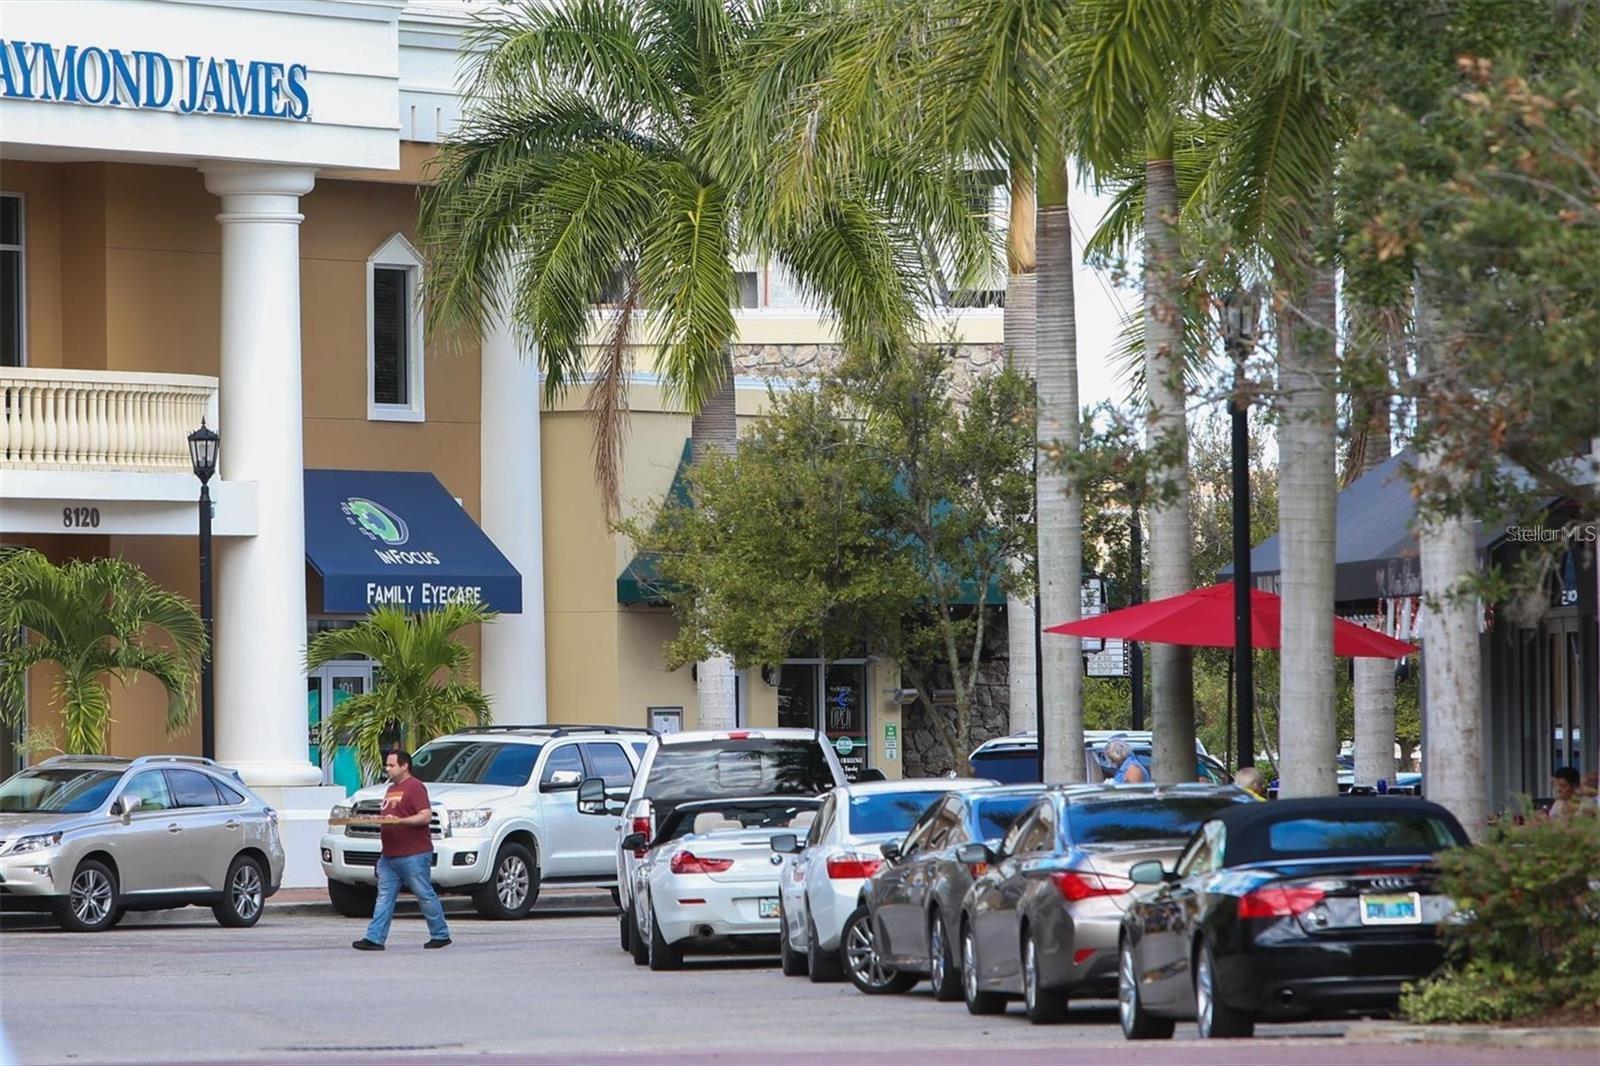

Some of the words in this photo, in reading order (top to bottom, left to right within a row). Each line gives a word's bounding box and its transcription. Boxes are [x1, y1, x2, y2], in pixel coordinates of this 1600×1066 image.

[179, 55, 309, 120] JAMES
[63, 507, 100, 528] 8120
[366, 582, 414, 604] FAMILY
[421, 582, 482, 605] EYECARE
